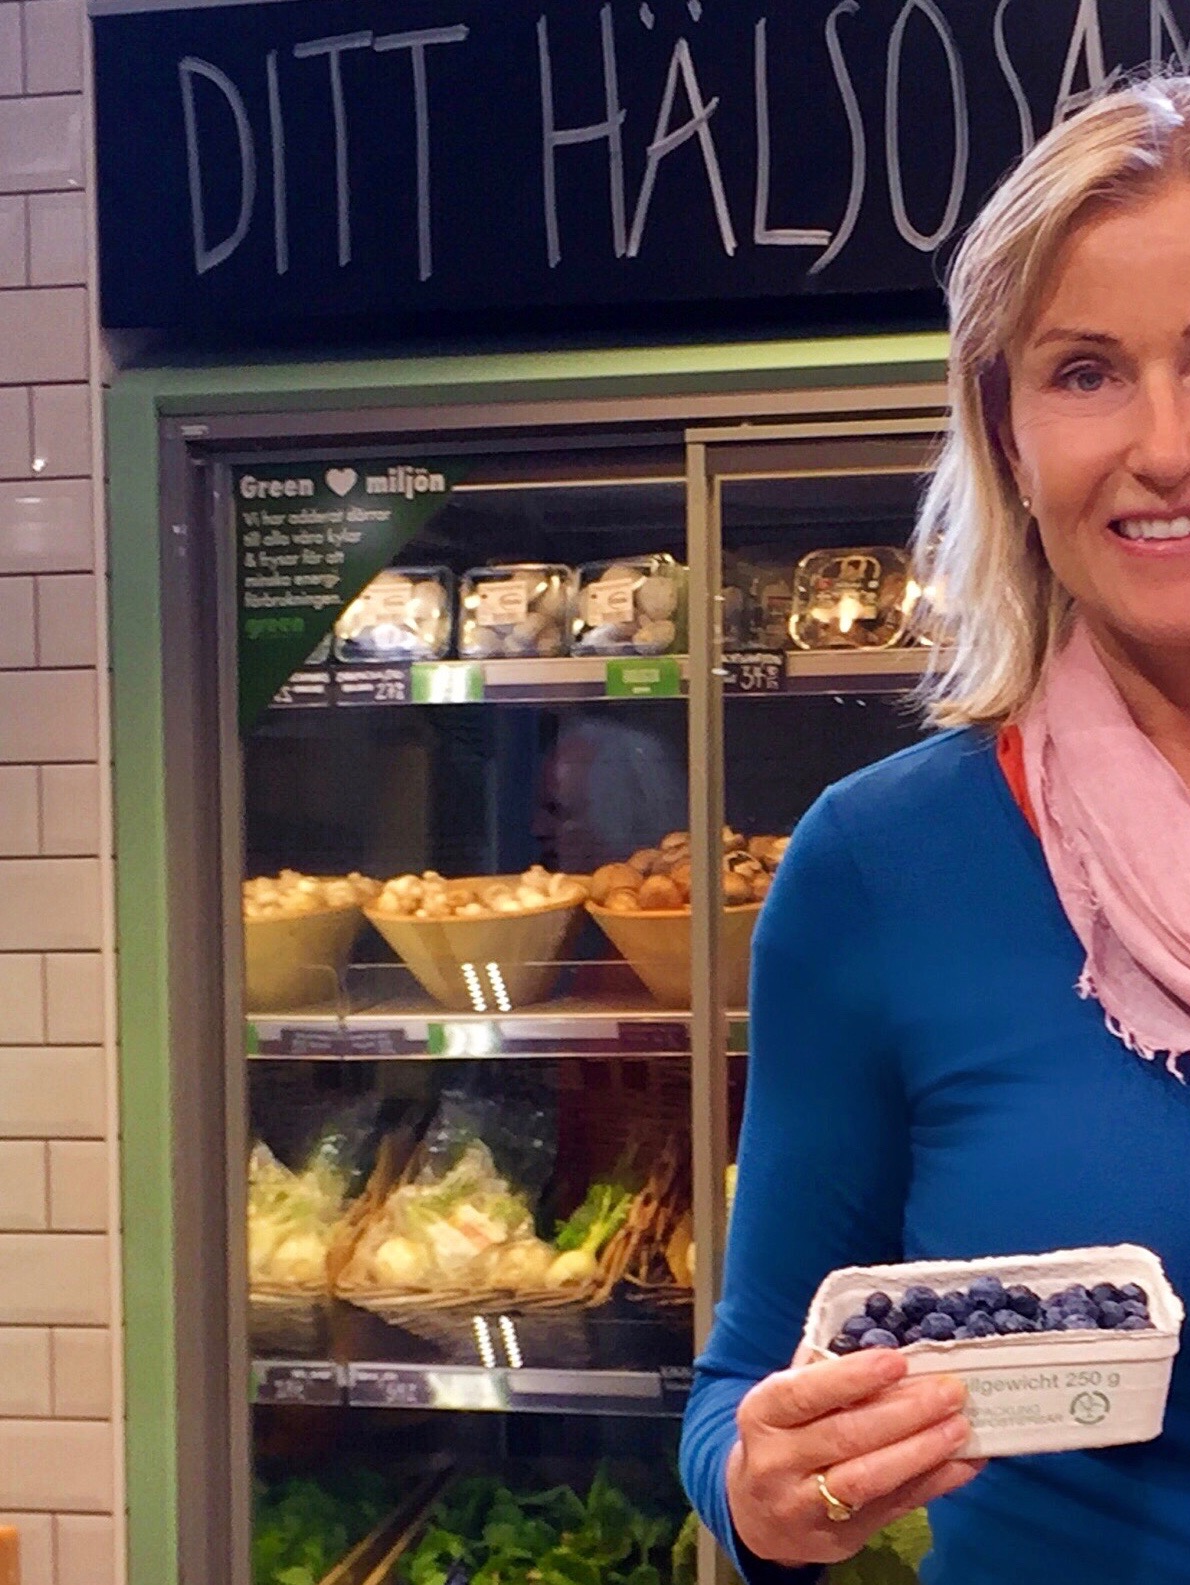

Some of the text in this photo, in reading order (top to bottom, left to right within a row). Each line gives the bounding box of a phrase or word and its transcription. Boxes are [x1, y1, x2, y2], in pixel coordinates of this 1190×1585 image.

[178, 24, 469, 281] DITT
[239, 465, 446, 500] Green miljön
[965, 1371, 1121, 1397] llgewicht 250 g
